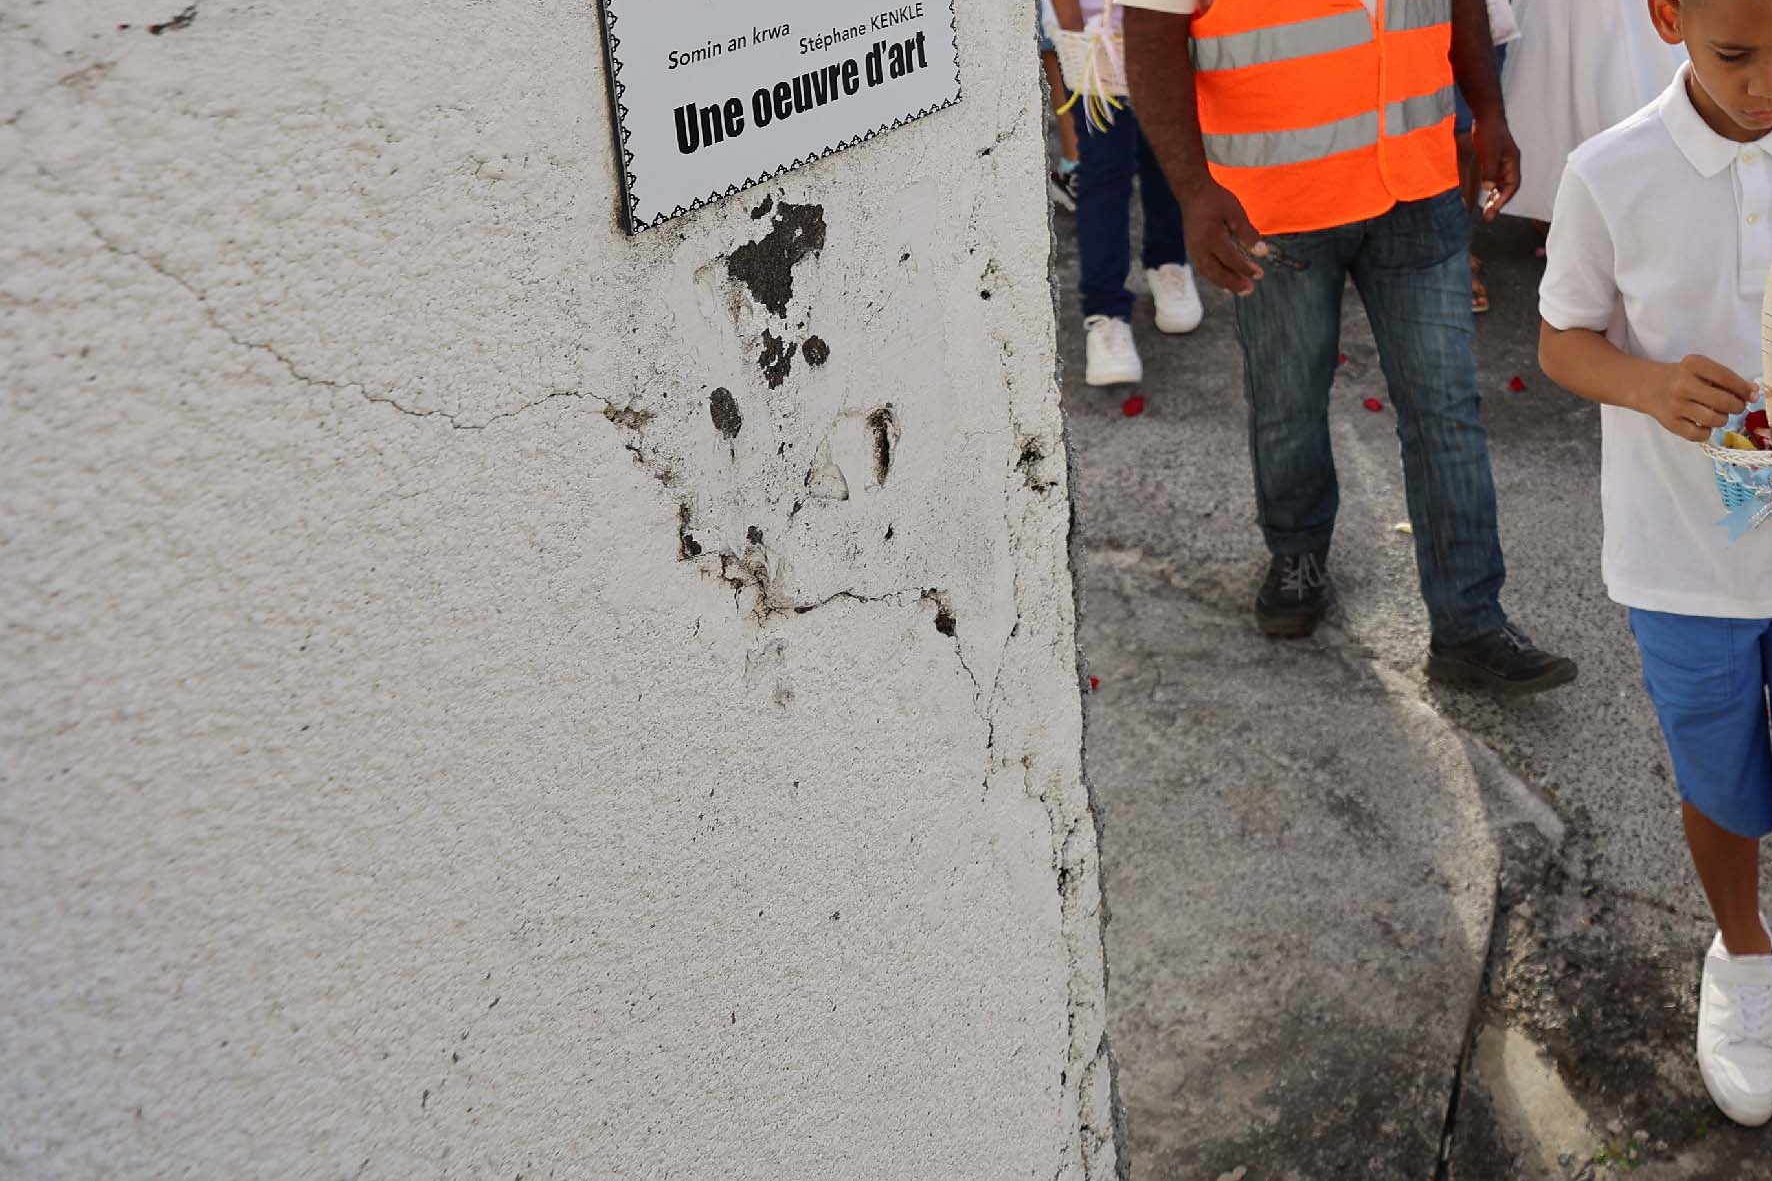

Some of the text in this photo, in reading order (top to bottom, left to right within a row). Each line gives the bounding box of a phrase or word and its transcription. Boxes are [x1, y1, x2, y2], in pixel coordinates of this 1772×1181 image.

[668, 22, 790, 70] Somin an krwa
[799, 2, 924, 54] Stéphane KENKLE
[673, 30, 928, 155] Une oeuvre d'art
